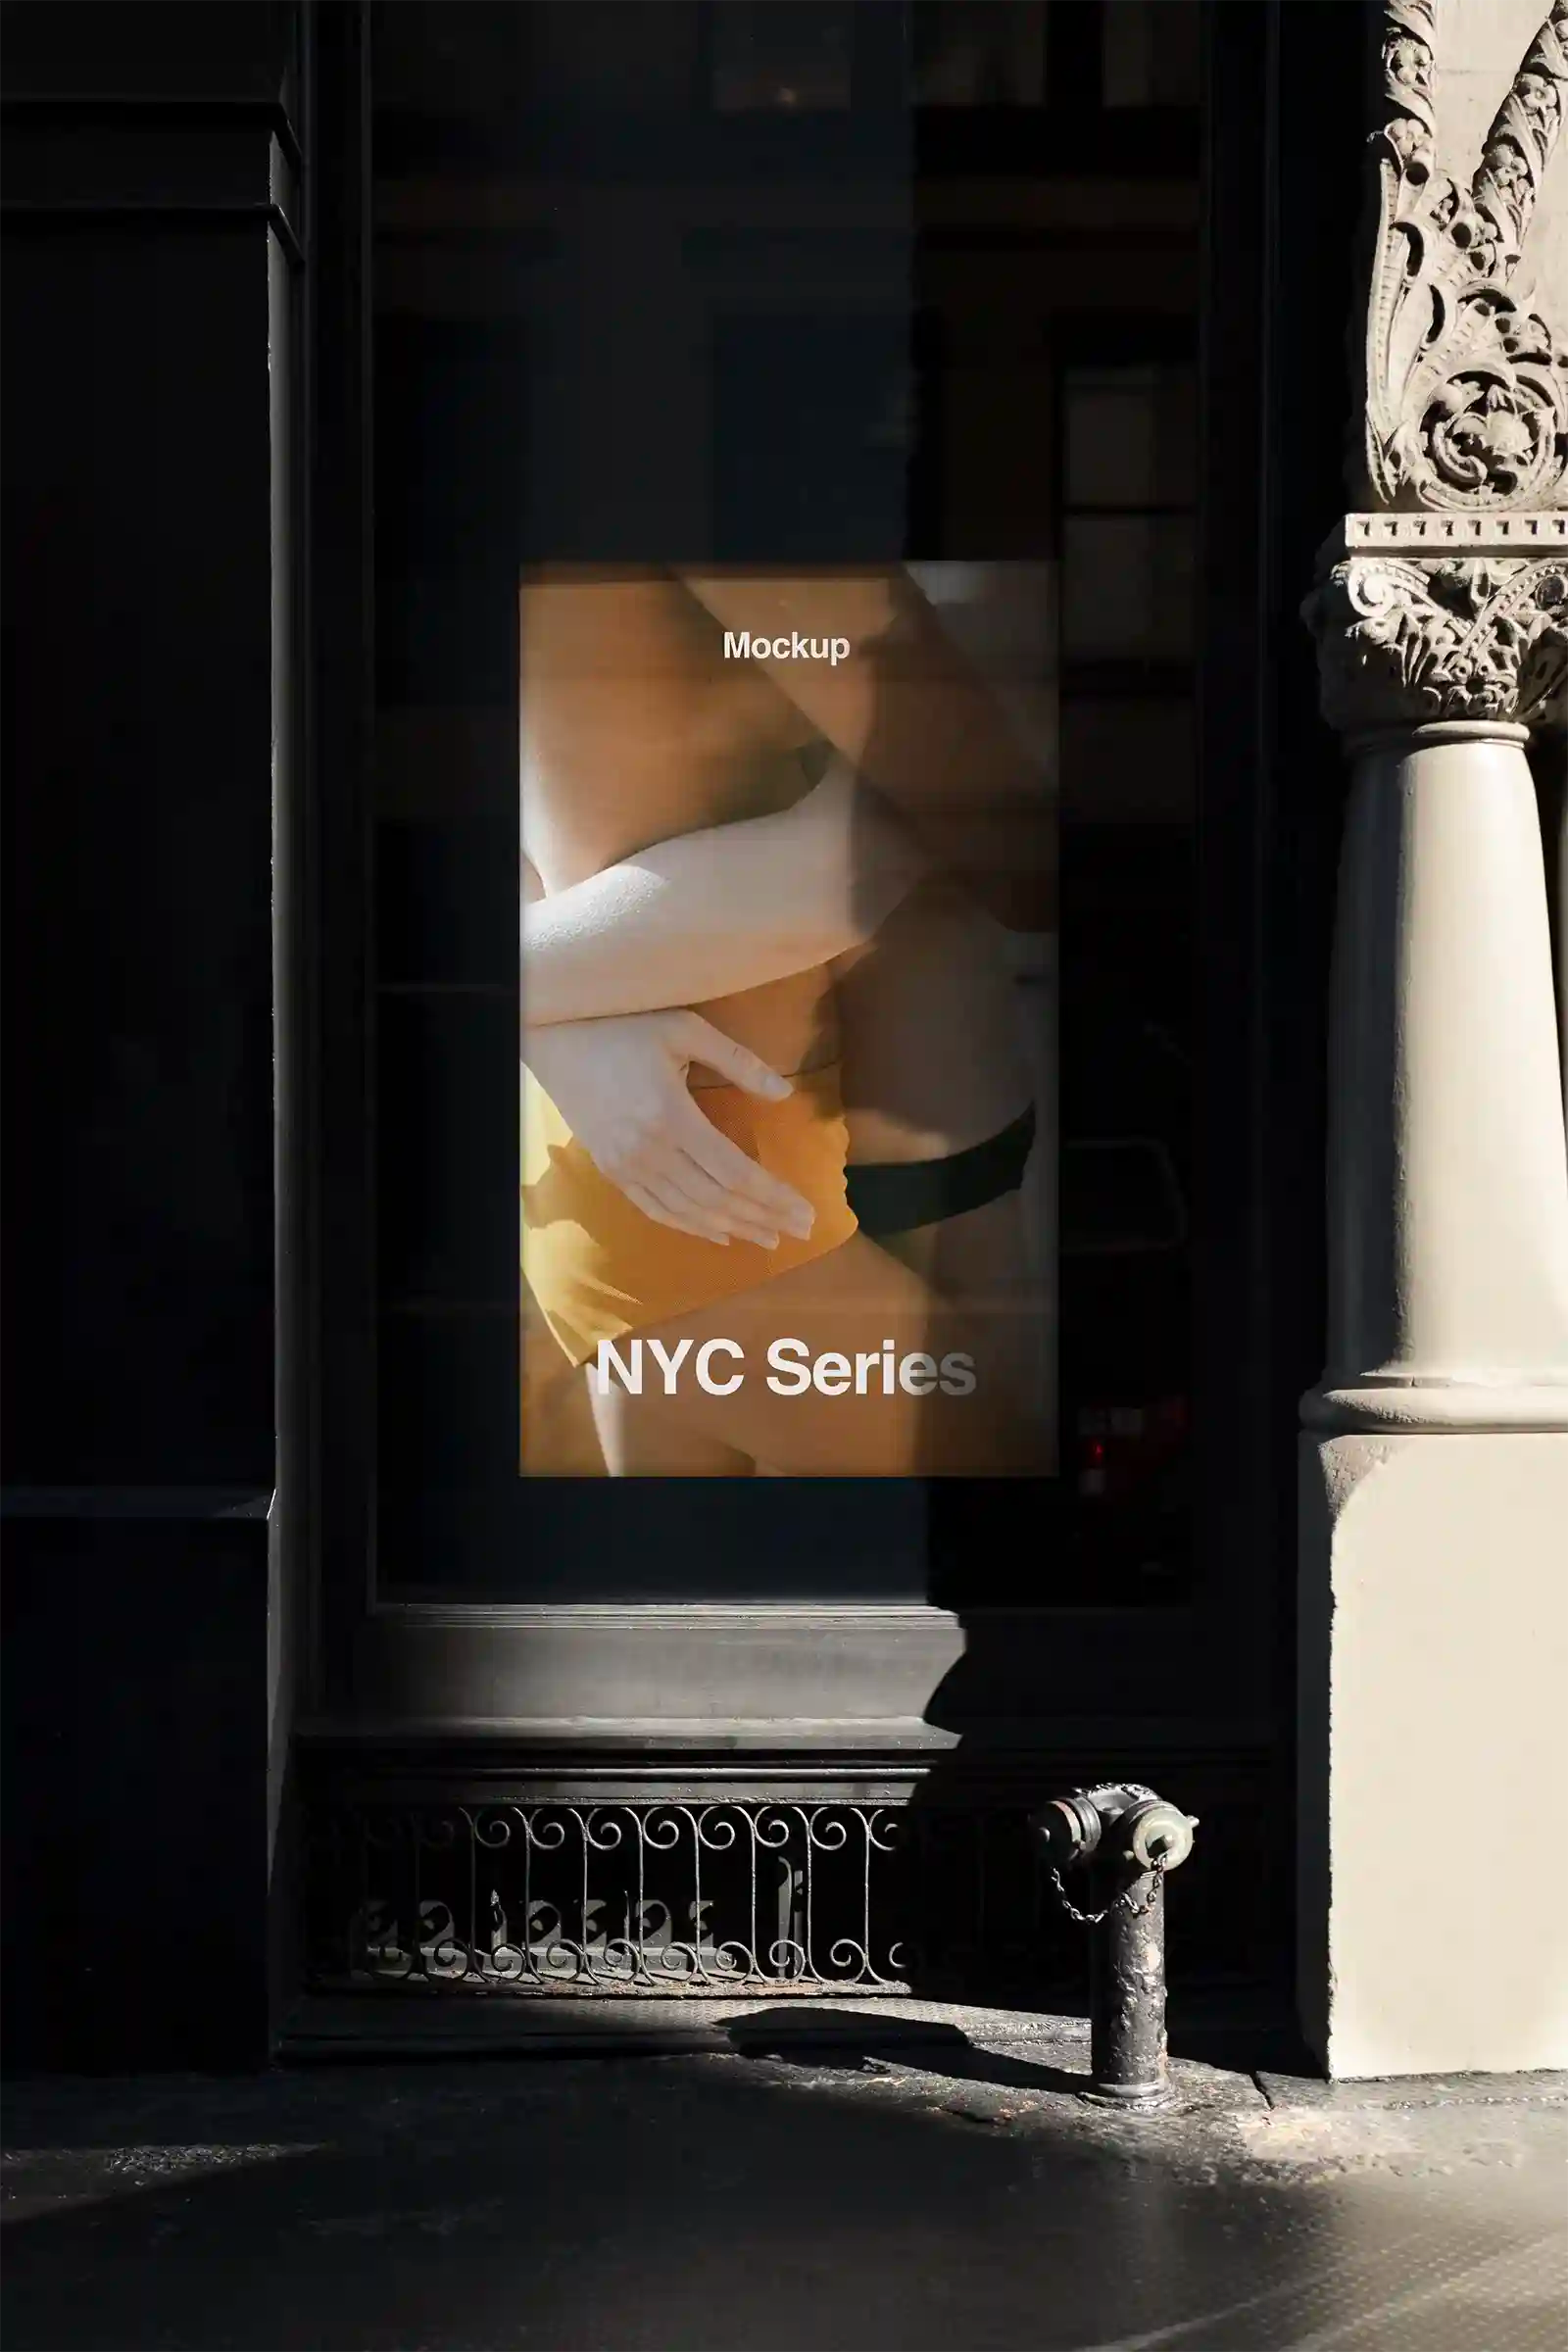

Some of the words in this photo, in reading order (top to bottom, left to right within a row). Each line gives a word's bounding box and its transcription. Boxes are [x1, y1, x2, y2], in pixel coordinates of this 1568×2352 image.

[723, 631, 851, 666] Mockup
[596, 1338, 746, 1396] NYC
[765, 1338, 977, 1396] Series
